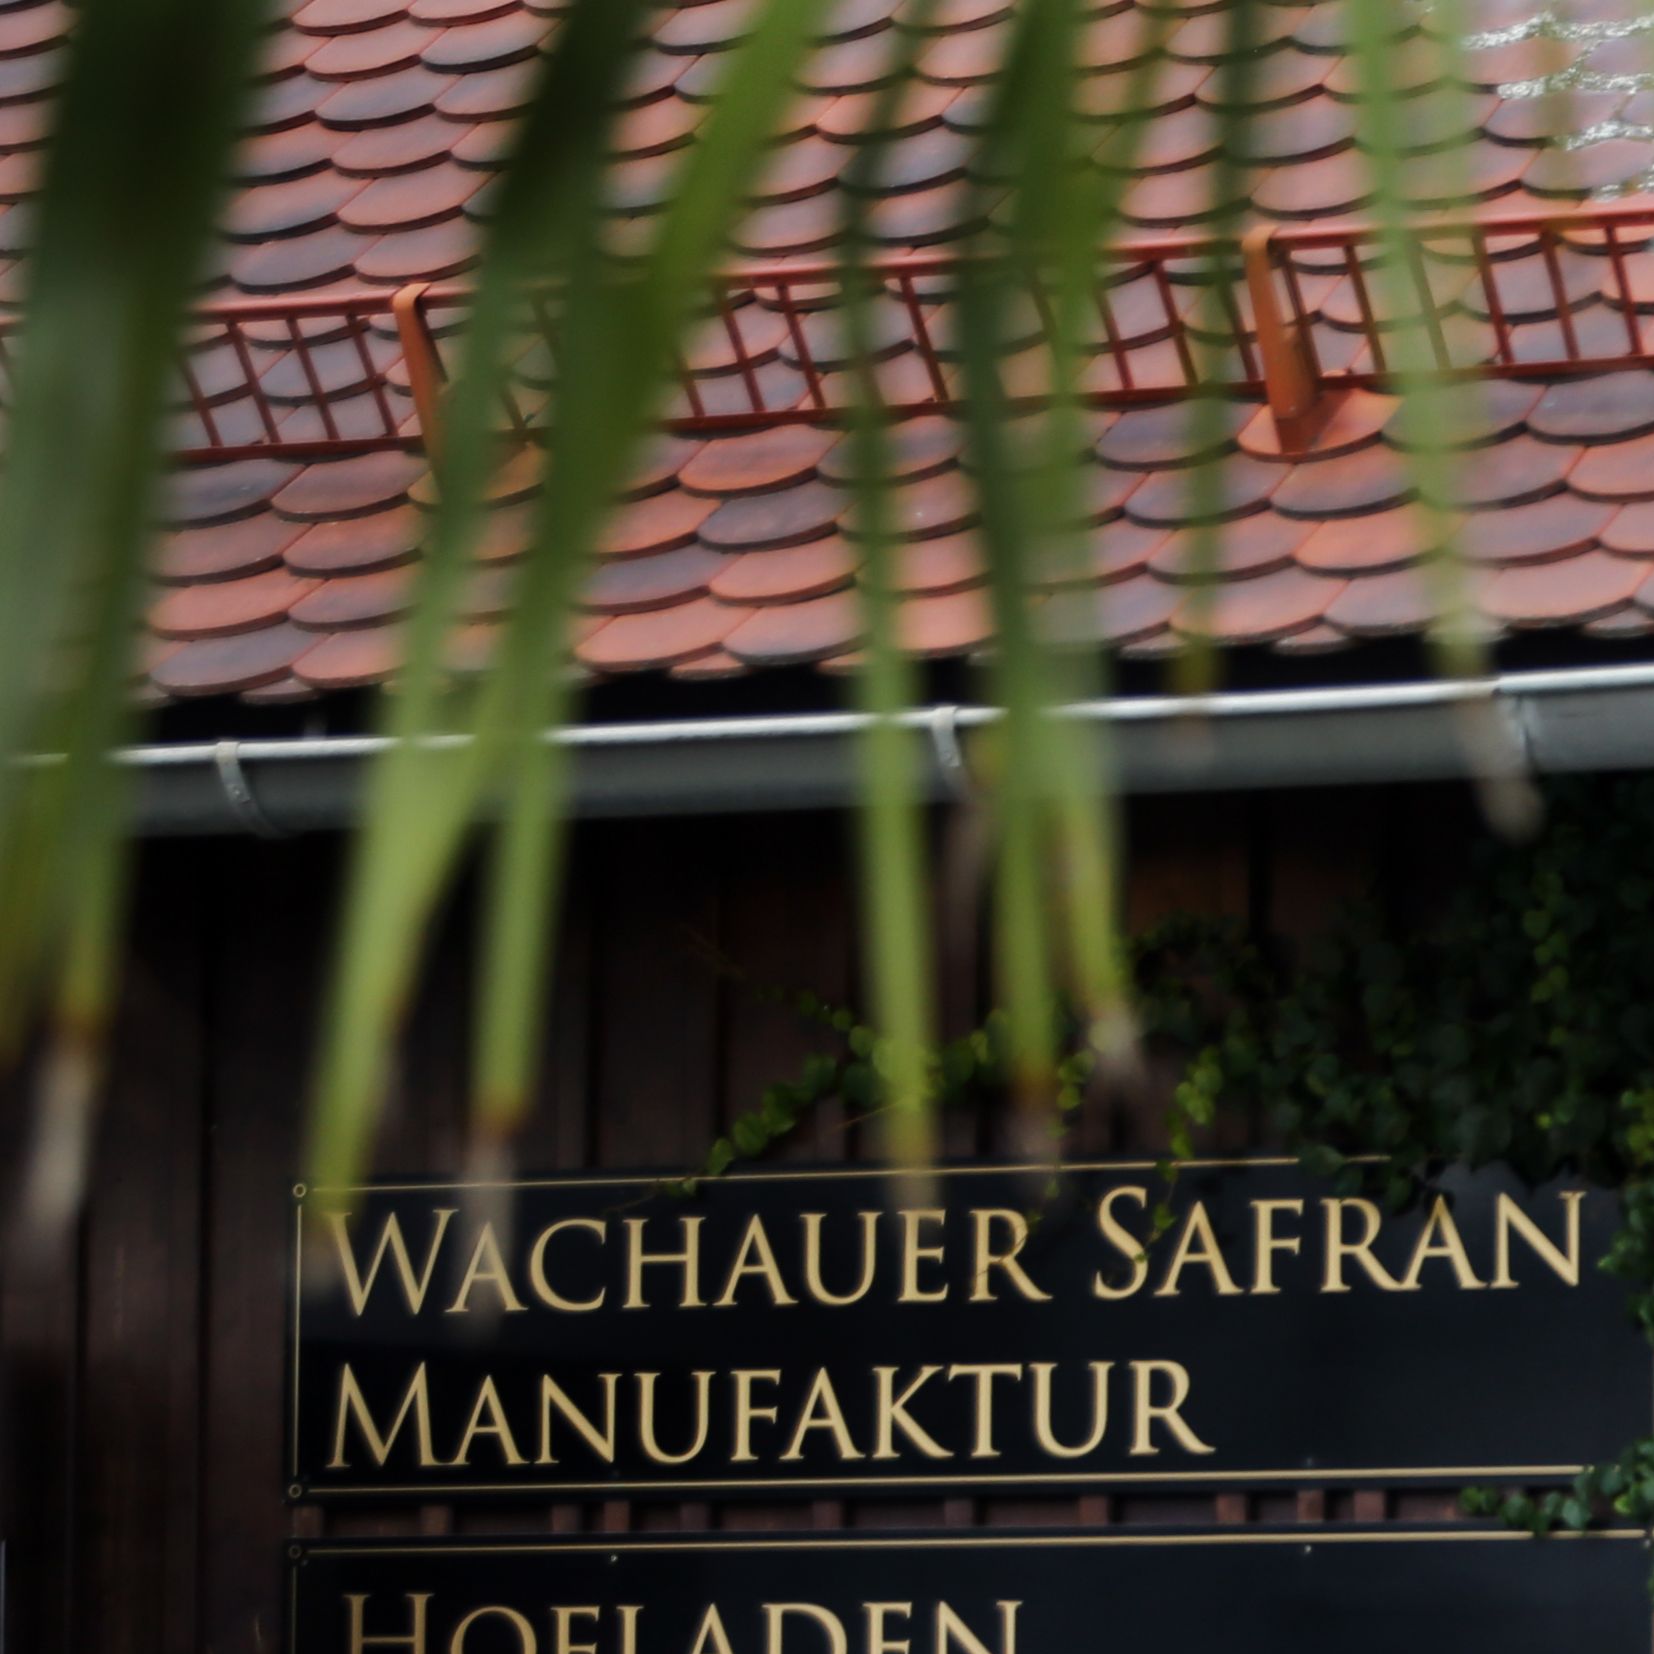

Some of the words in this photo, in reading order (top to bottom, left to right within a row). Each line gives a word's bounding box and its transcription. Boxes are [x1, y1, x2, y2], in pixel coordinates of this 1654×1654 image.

[328, 1208, 1053, 1317] WACHAUER
[1093, 1185, 1586, 1300] SAFRAN
[329, 1359, 1216, 1467] MANUFAKTUR
